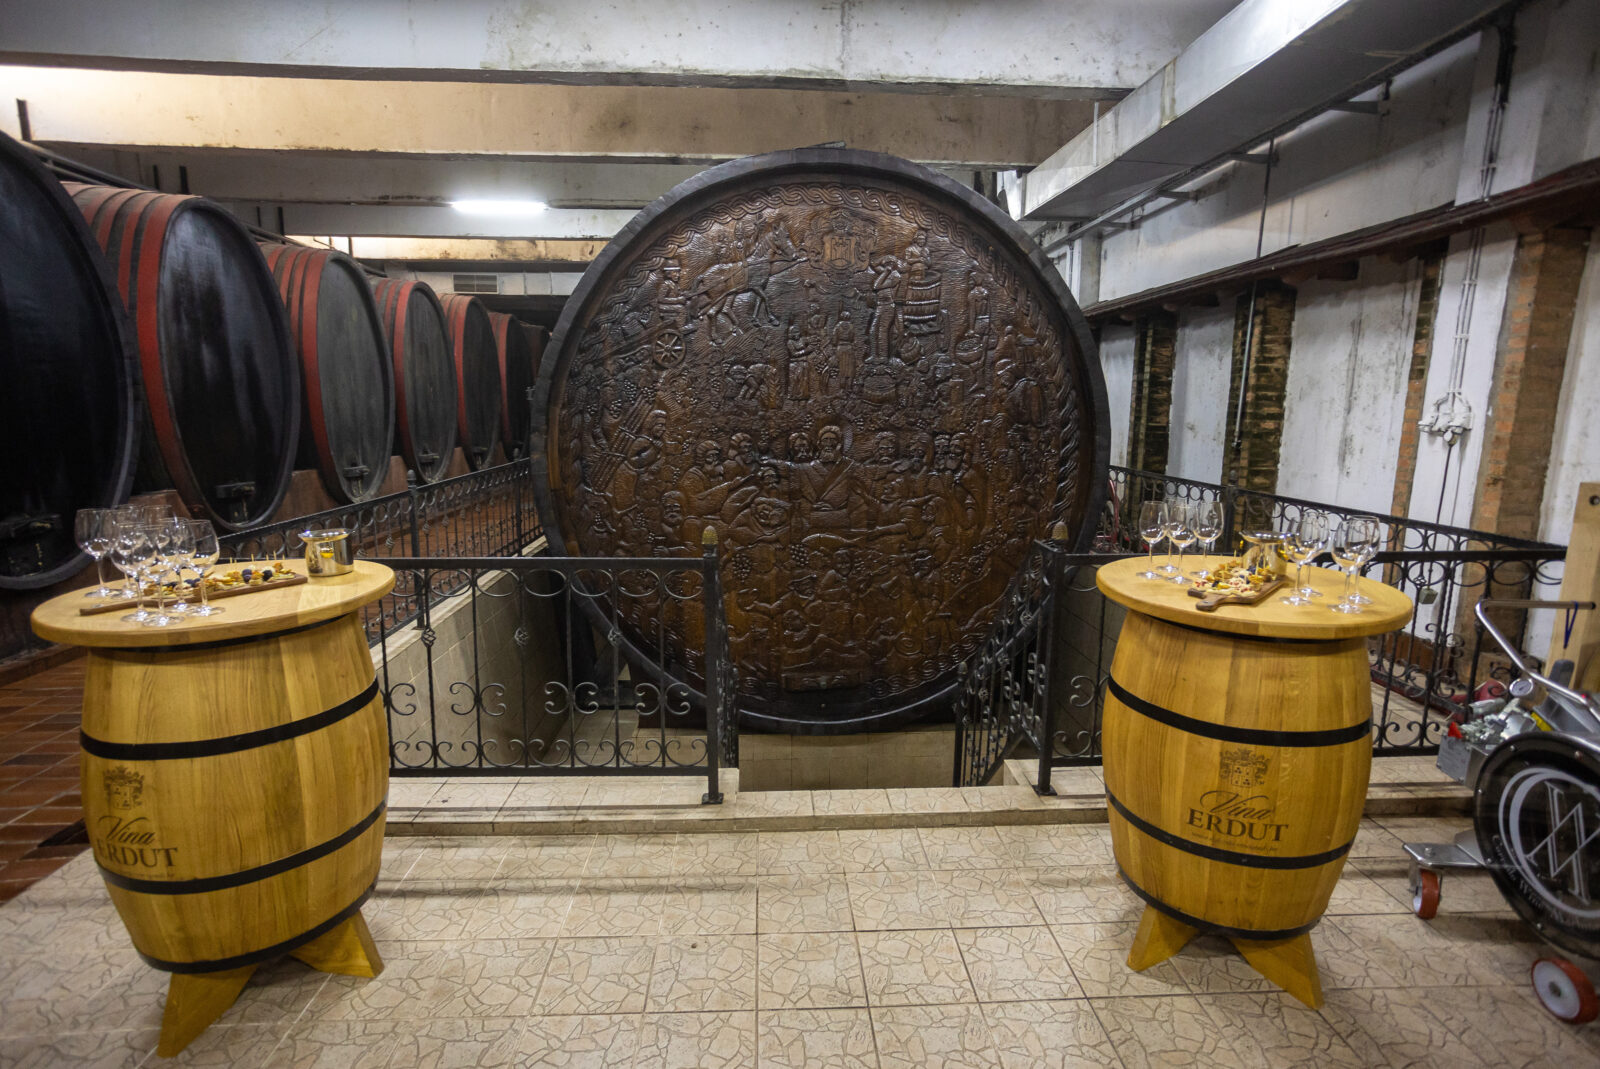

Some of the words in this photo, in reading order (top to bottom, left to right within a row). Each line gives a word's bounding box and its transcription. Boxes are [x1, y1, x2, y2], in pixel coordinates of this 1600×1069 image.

[1200, 790, 1272, 820] Vina
[98, 815, 155, 845] Vina
[1187, 808, 1289, 841] ERDUT
